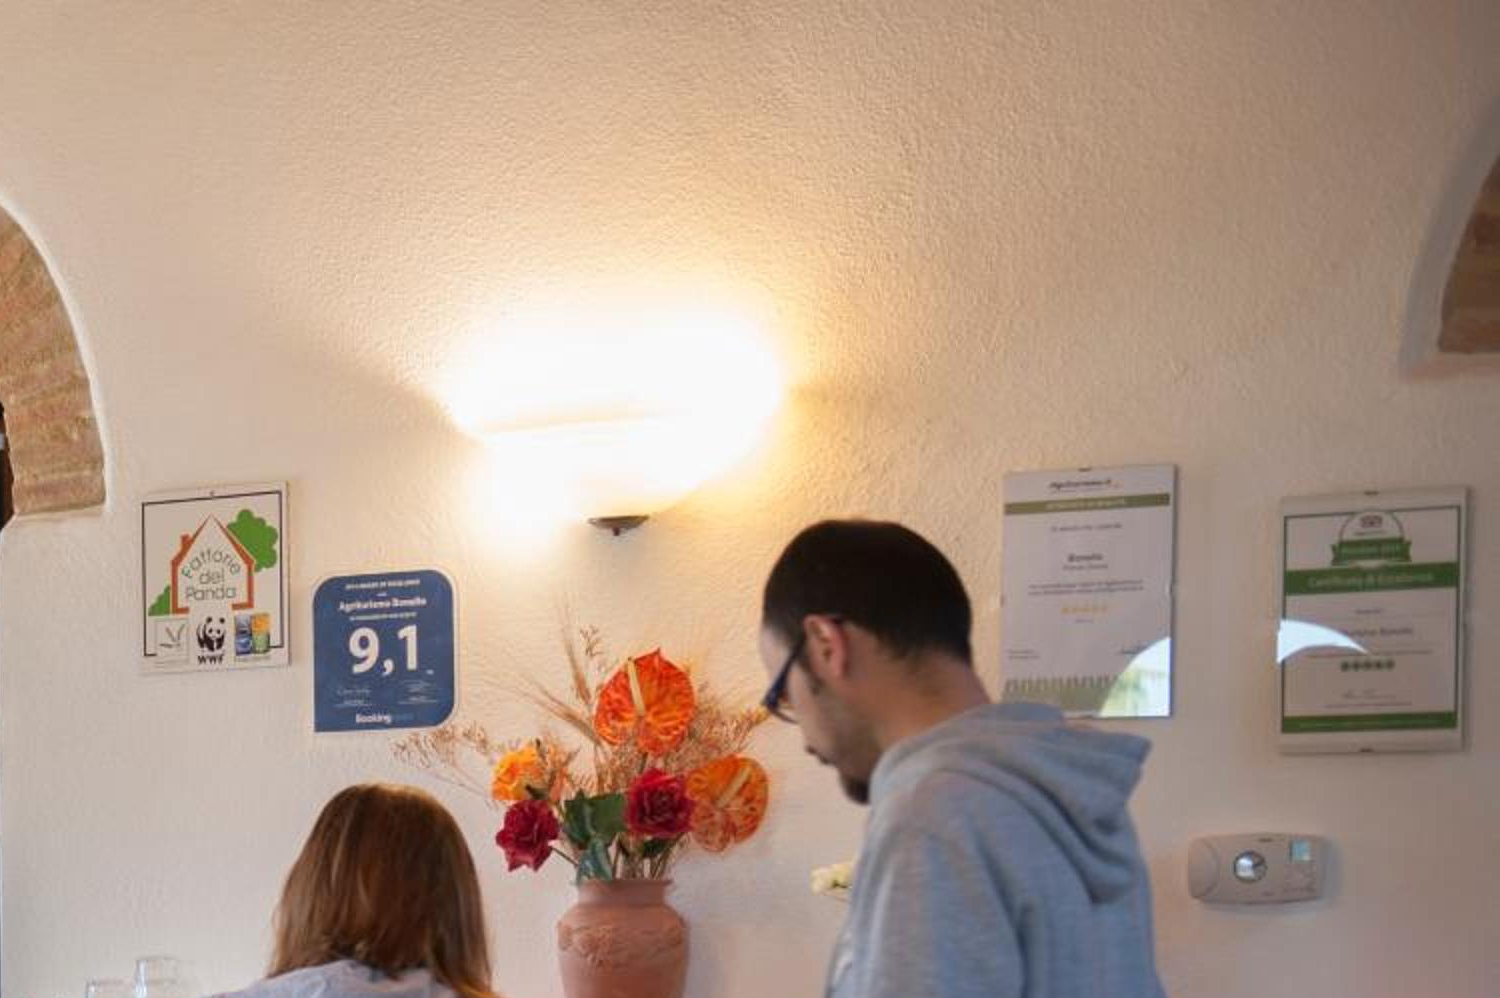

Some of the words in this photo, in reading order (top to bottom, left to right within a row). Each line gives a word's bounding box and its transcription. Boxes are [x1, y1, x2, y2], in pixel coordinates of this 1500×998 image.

[181, 547, 241, 579] Fattorie
[199, 567, 225, 585] del
[185, 585, 237, 601] Panda
[349, 624, 418, 676] 9,1
[197, 654, 224, 665] WWF
